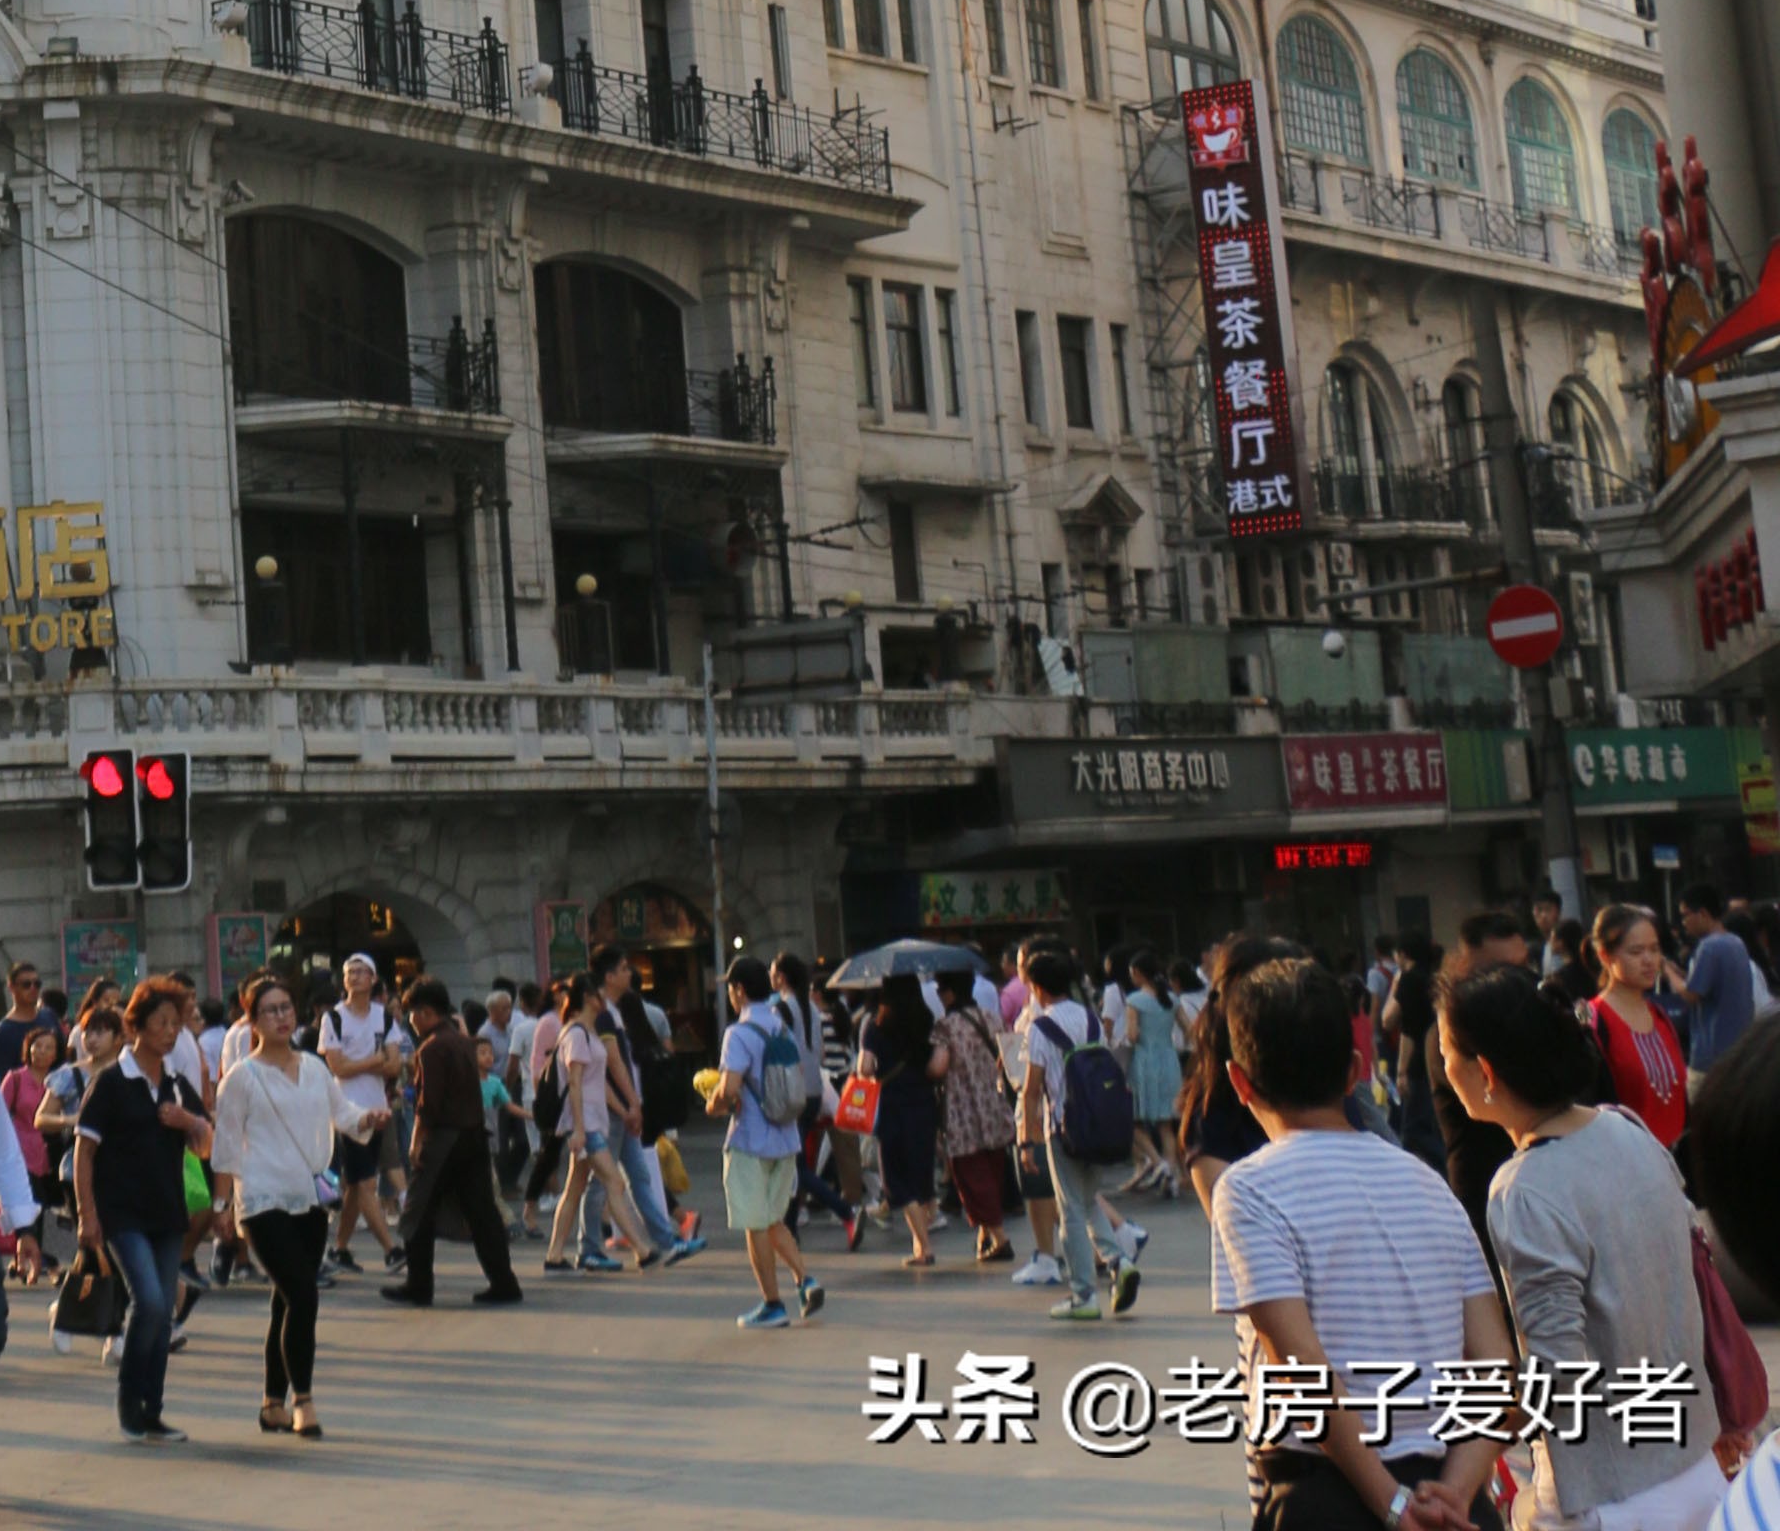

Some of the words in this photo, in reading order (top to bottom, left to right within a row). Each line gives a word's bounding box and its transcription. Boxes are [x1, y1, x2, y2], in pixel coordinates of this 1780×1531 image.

[1201, 181, 1276, 471] 味皇茶餐厅
[1225, 475, 1293, 516] 港式
[1071, 749, 1230, 792] 大光明商务中心
